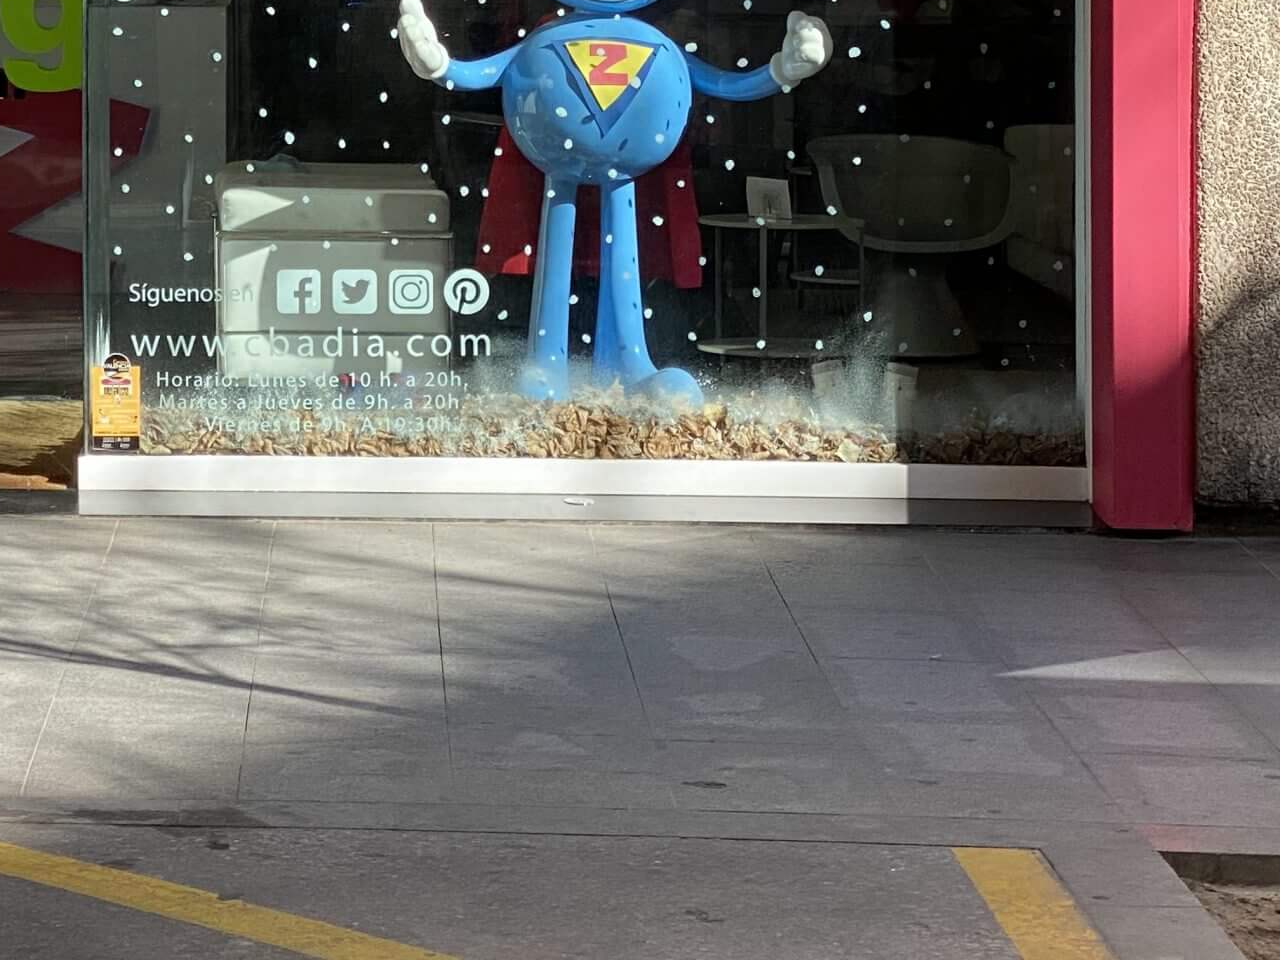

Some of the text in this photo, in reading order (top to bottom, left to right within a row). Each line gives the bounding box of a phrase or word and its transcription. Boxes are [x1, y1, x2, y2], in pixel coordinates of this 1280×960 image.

[129, 283, 254, 307] Síguenos en
[131, 326, 492, 358] www.cbadia.com
[156, 370, 240, 388] Horario:
[248, 372, 307, 388] Lunes
[315, 371, 339, 388] de
[348, 372, 371, 388] 10
[380, 371, 398, 388] h.
[405, 375, 416, 388] a
[159, 394, 229, 410] Martes
[236, 398, 247, 410] a
[256, 394, 324, 410] Jueves
[331, 394, 356, 410] de
[403, 398, 414, 410] a
[204, 416, 281, 432] Viernes
[289, 417, 313, 432] de
[361, 417, 374, 432] A
